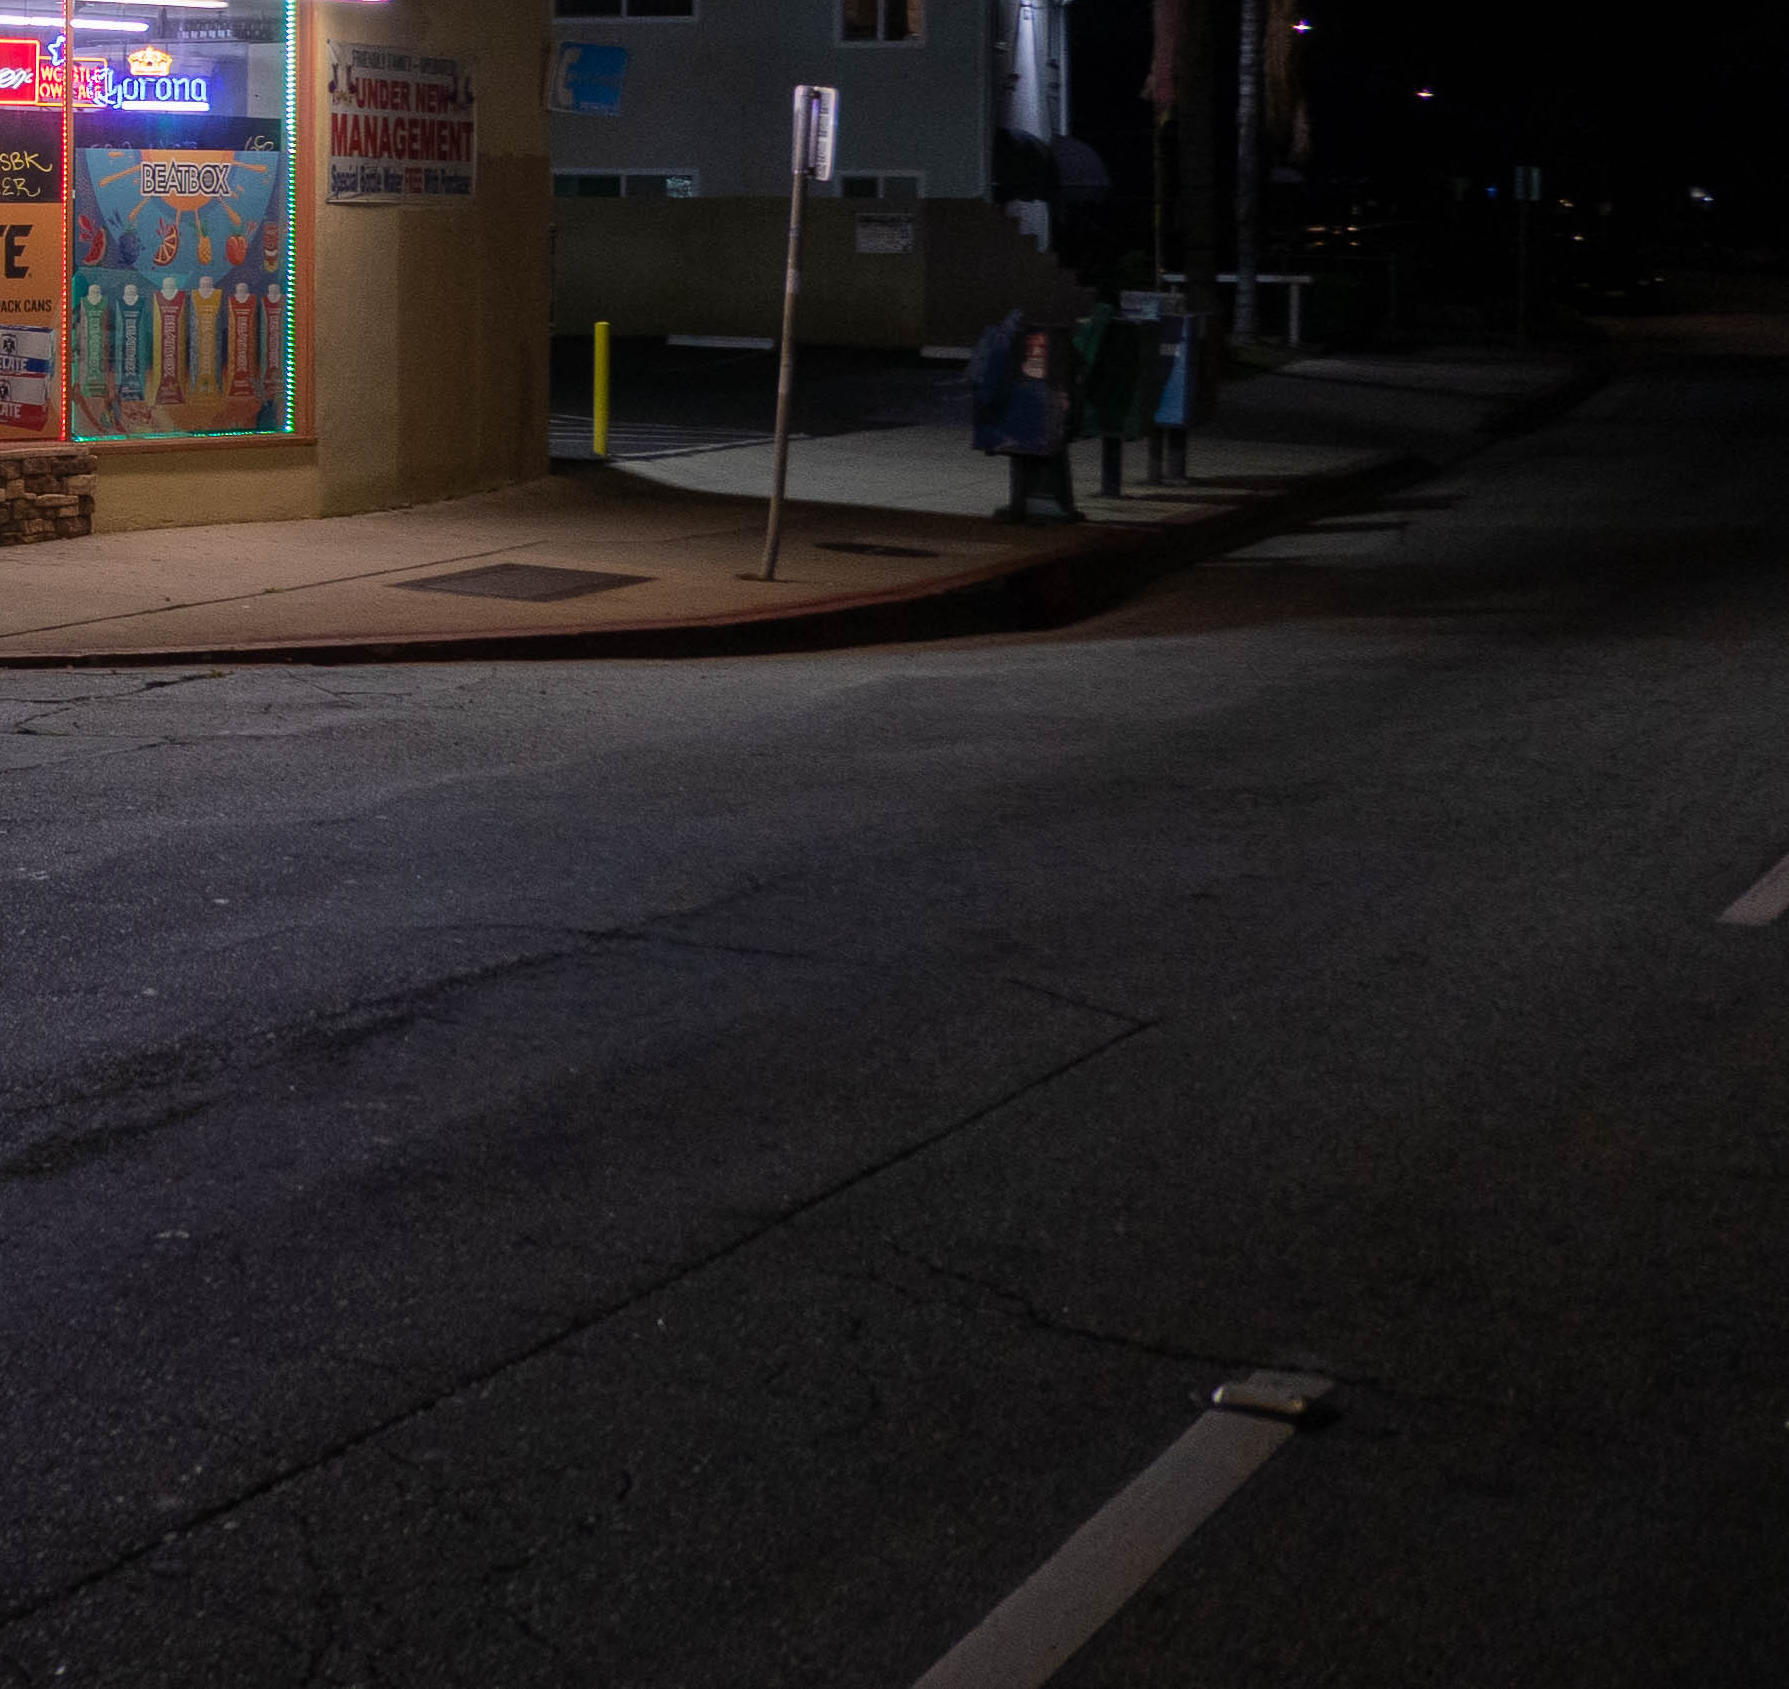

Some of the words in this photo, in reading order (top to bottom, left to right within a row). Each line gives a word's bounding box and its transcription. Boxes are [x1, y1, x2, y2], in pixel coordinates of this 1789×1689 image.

[87, 67, 207, 109] Corona
[355, 78, 410, 111] UNDER
[416, 83, 449, 113] NEW
[331, 113, 474, 161] MANAGEMENT
[141, 162, 230, 195] BEATBOX
[24, 299, 52, 312] CANS
